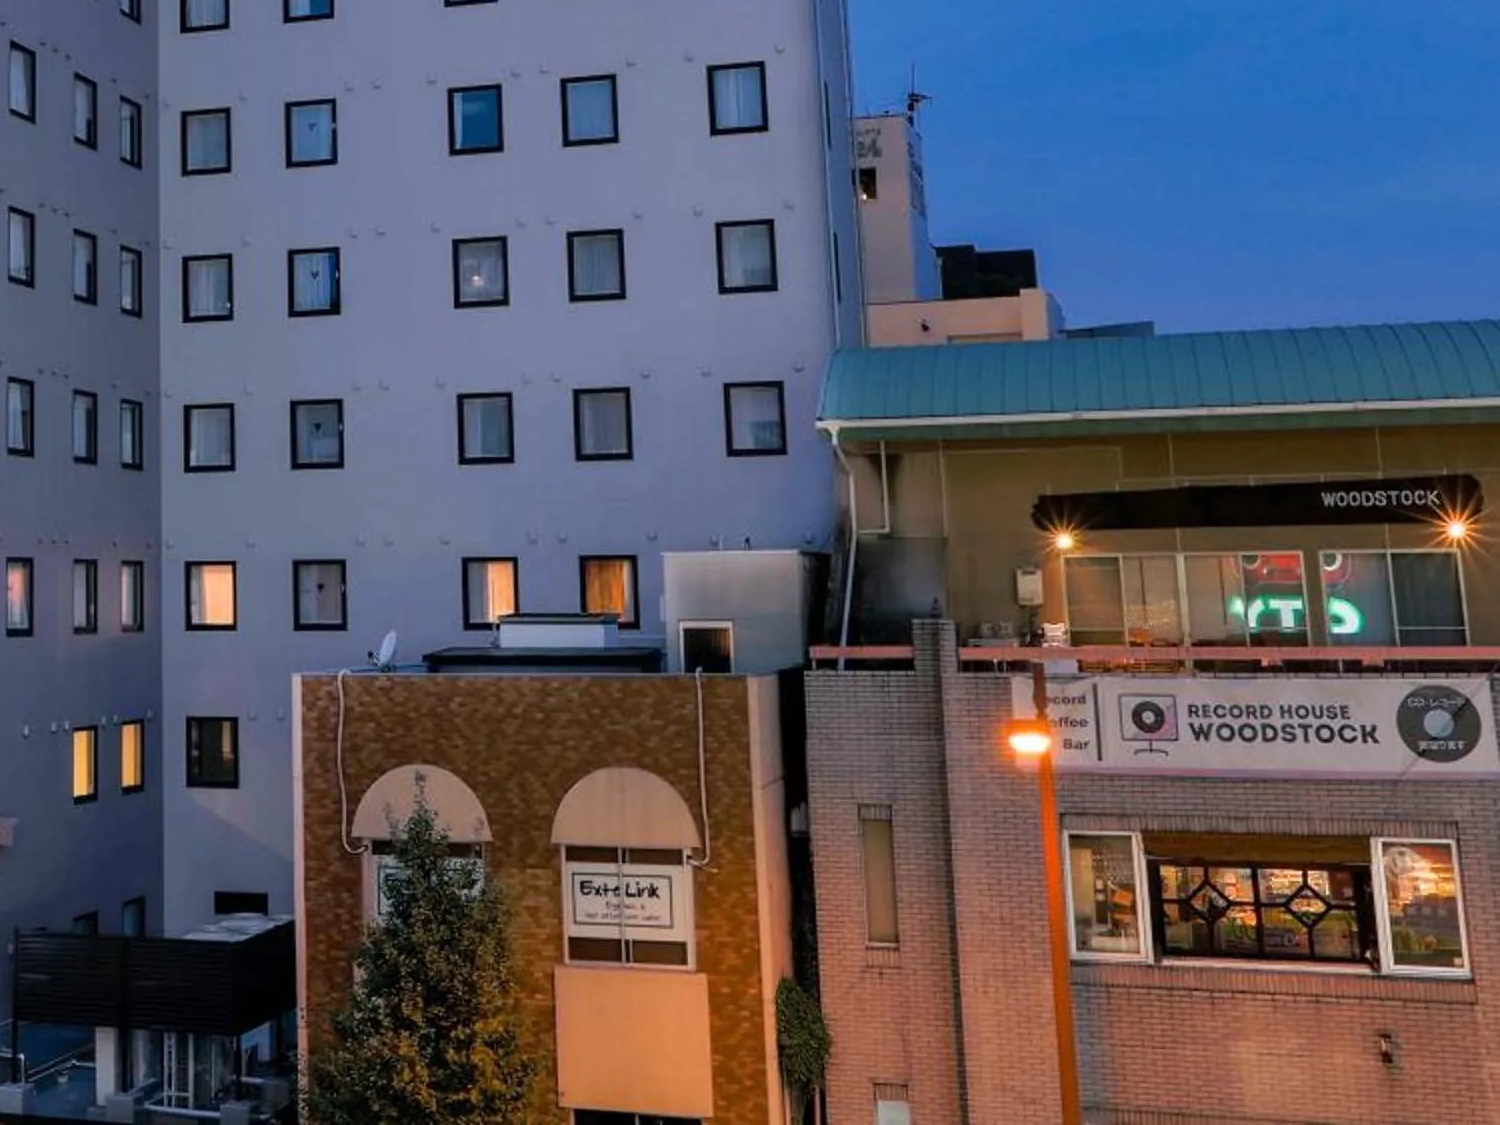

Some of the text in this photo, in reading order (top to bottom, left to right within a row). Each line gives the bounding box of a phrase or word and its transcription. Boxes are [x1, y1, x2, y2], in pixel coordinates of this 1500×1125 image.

[1321, 490, 1441, 508] WOODSTOCK
[1187, 704, 1352, 720] RECORD HOUSE
[1188, 722, 1380, 744] WOODSTOCK
[1063, 738, 1091, 751] Bar
